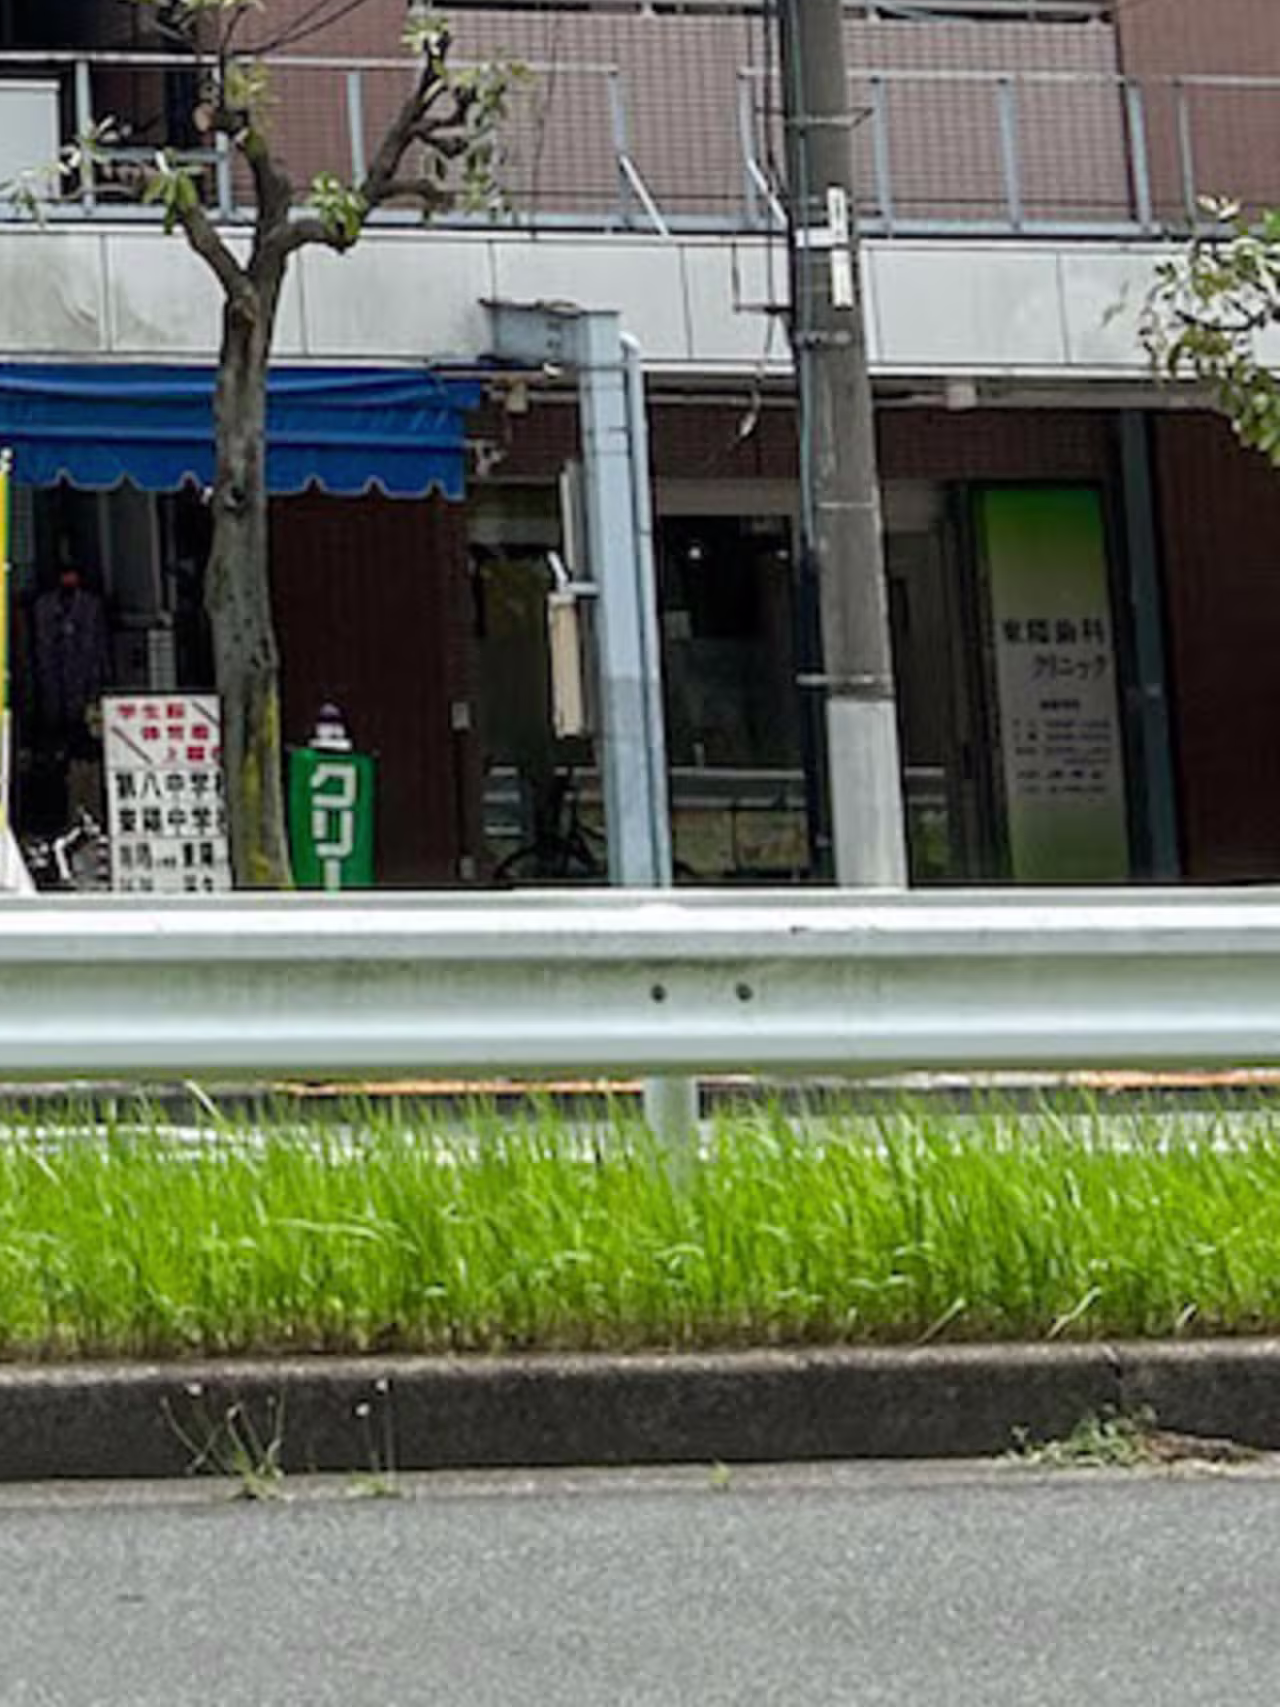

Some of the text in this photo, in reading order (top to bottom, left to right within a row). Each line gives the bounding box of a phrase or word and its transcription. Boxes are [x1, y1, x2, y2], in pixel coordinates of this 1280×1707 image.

[1032, 654, 1107, 681] クリニック
